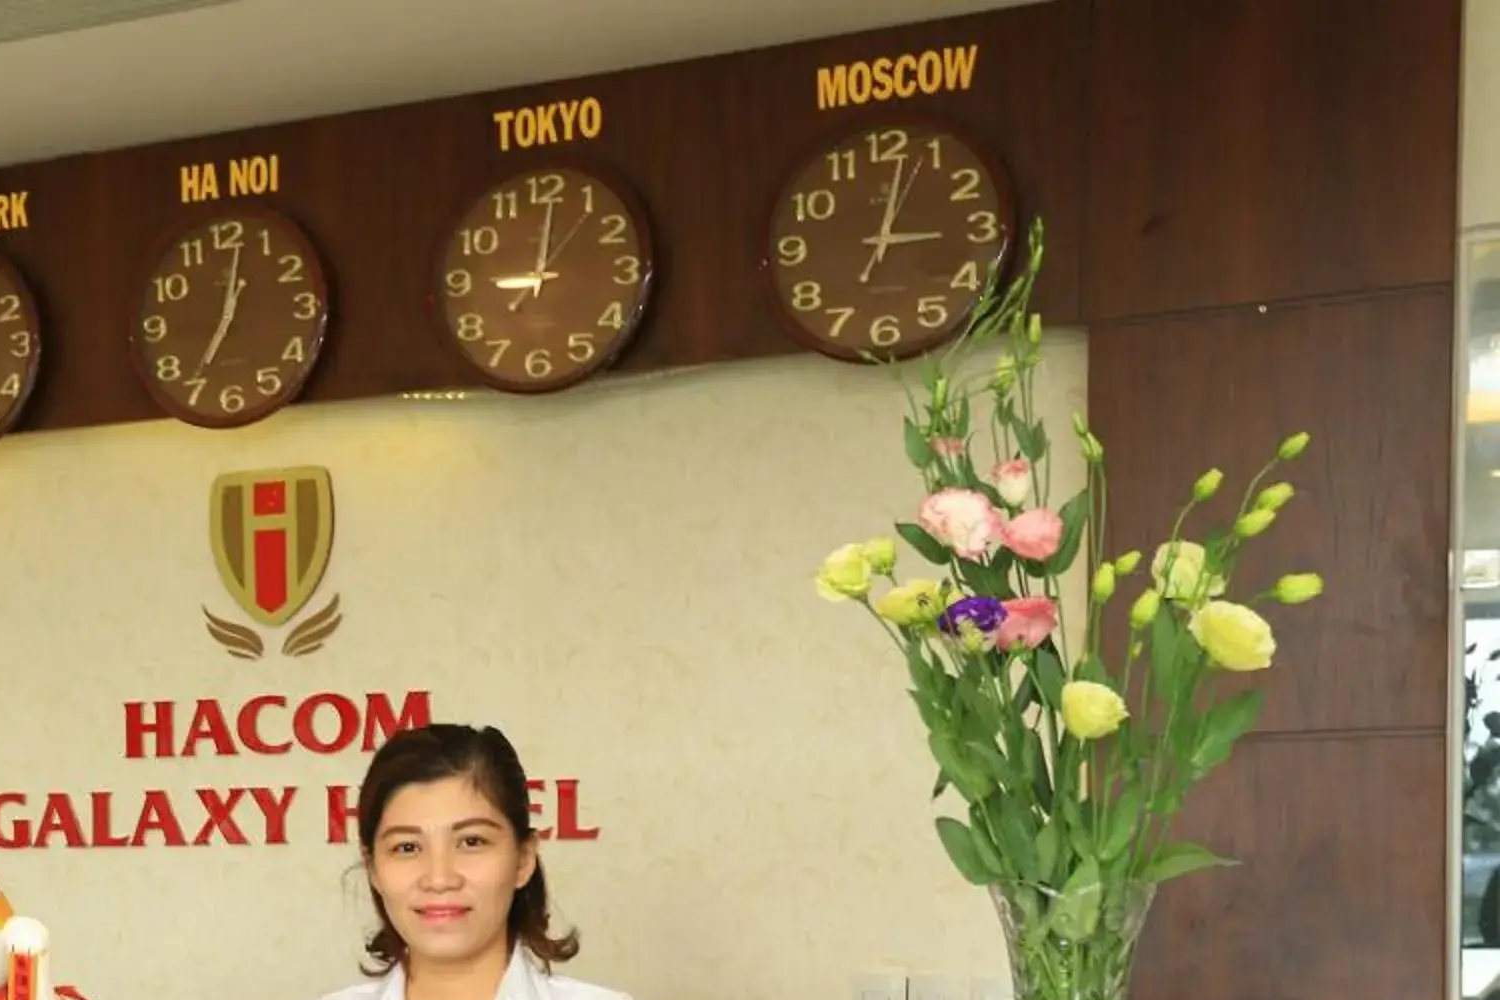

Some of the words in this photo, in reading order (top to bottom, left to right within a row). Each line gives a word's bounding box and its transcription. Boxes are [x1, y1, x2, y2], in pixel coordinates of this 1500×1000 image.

[817, 44, 978, 110] MOSCOW
[493, 97, 601, 151] TOKYO
[866, 130, 908, 161] 12
[927, 139, 941, 169] 1
[180, 163, 219, 202] HA
[230, 154, 279, 196] NOI
[826, 150, 857, 181] 11
[527, 175, 564, 203] 12
[949, 169, 980, 200] 2
[493, 192, 517, 219] 11
[581, 186, 593, 211] 1
[792, 190, 835, 222] 10
[210, 221, 243, 248] 12
[460, 226, 497, 254] 10
[600, 216, 627, 243] 2
[966, 211, 997, 242] 3
[180, 240, 203, 266] 11
[260, 230, 271, 255] 1
[778, 236, 807, 266] 9
[278, 256, 302, 283] 2
[446, 269, 471, 296] 9
[614, 257, 639, 283] 3
[950, 261, 980, 291] 4
[154, 275, 188, 301] 10
[792, 282, 822, 311] 8
[293, 294, 316, 319] 3
[598, 302, 624, 328] 4
[917, 297, 948, 328] 5
[144, 316, 167, 342] 9
[457, 314, 483, 341] 8
[826, 307, 855, 336] 7
[870, 315, 900, 346] 6
[10, 333, 30, 357] 3
[282, 337, 304, 362] 4
[485, 341, 510, 367] 7
[568, 333, 595, 361] 5
[157, 356, 180, 380] 8
[525, 350, 551, 376] 6
[0, 374, 20, 398] 4
[184, 378, 207, 405] 7
[257, 369, 282, 394] 5
[220, 386, 244, 411] 6
[122, 690, 431, 759] HACOM
